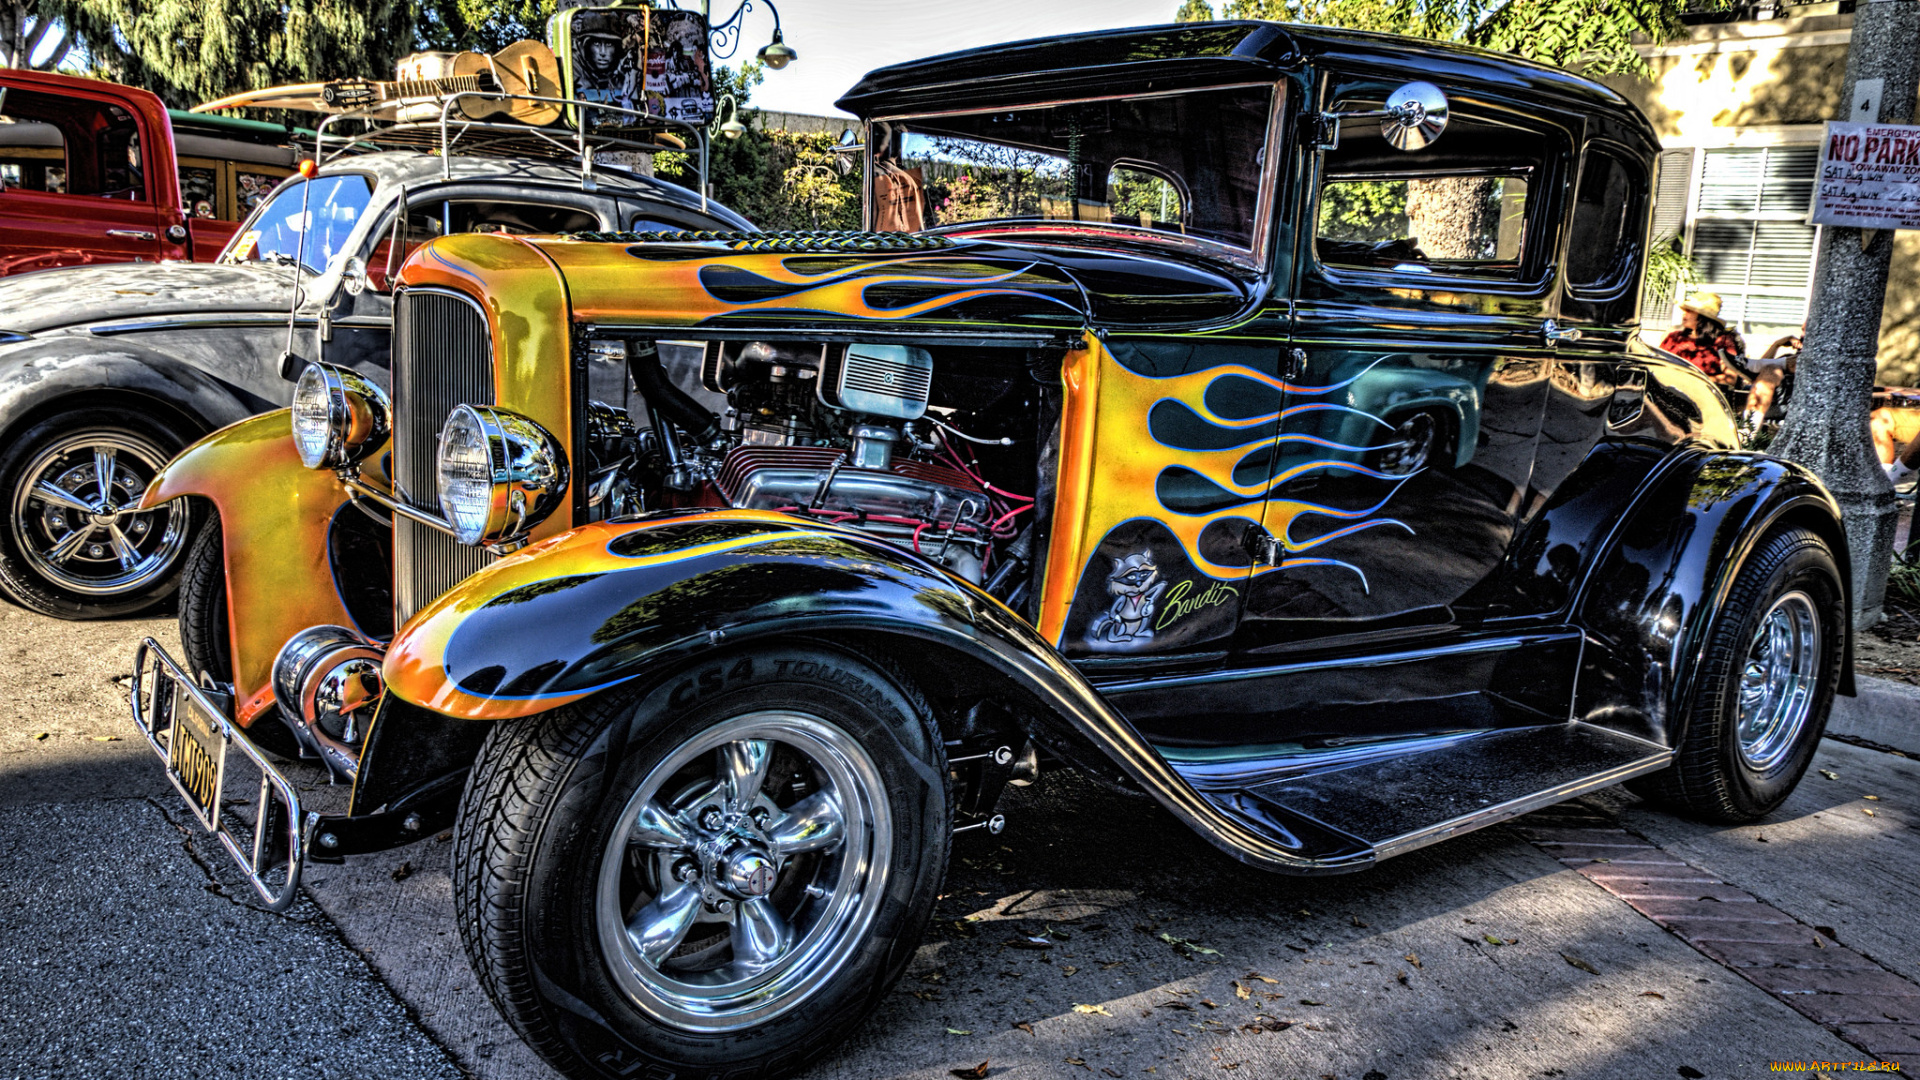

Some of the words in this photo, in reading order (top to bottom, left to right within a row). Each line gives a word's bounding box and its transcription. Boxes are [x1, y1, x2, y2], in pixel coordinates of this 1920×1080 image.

[1861, 99, 1870, 112] 4
[1828, 134, 1860, 162] NO
[1863, 137, 1920, 165] PARK
[1823, 165, 1843, 179] SAT
[1845, 169, 1863, 186] Aug
[1851, 163, 1901, 174] TOW-AWAY
[1903, 166, 1920, 175] ZO
[1821, 184, 1838, 196] SAT
[1840, 186, 1857, 203] Aug
[1156, 580, 1239, 630] Bandit
[668, 657, 754, 709] CS4
[774, 658, 907, 728] TOURING
